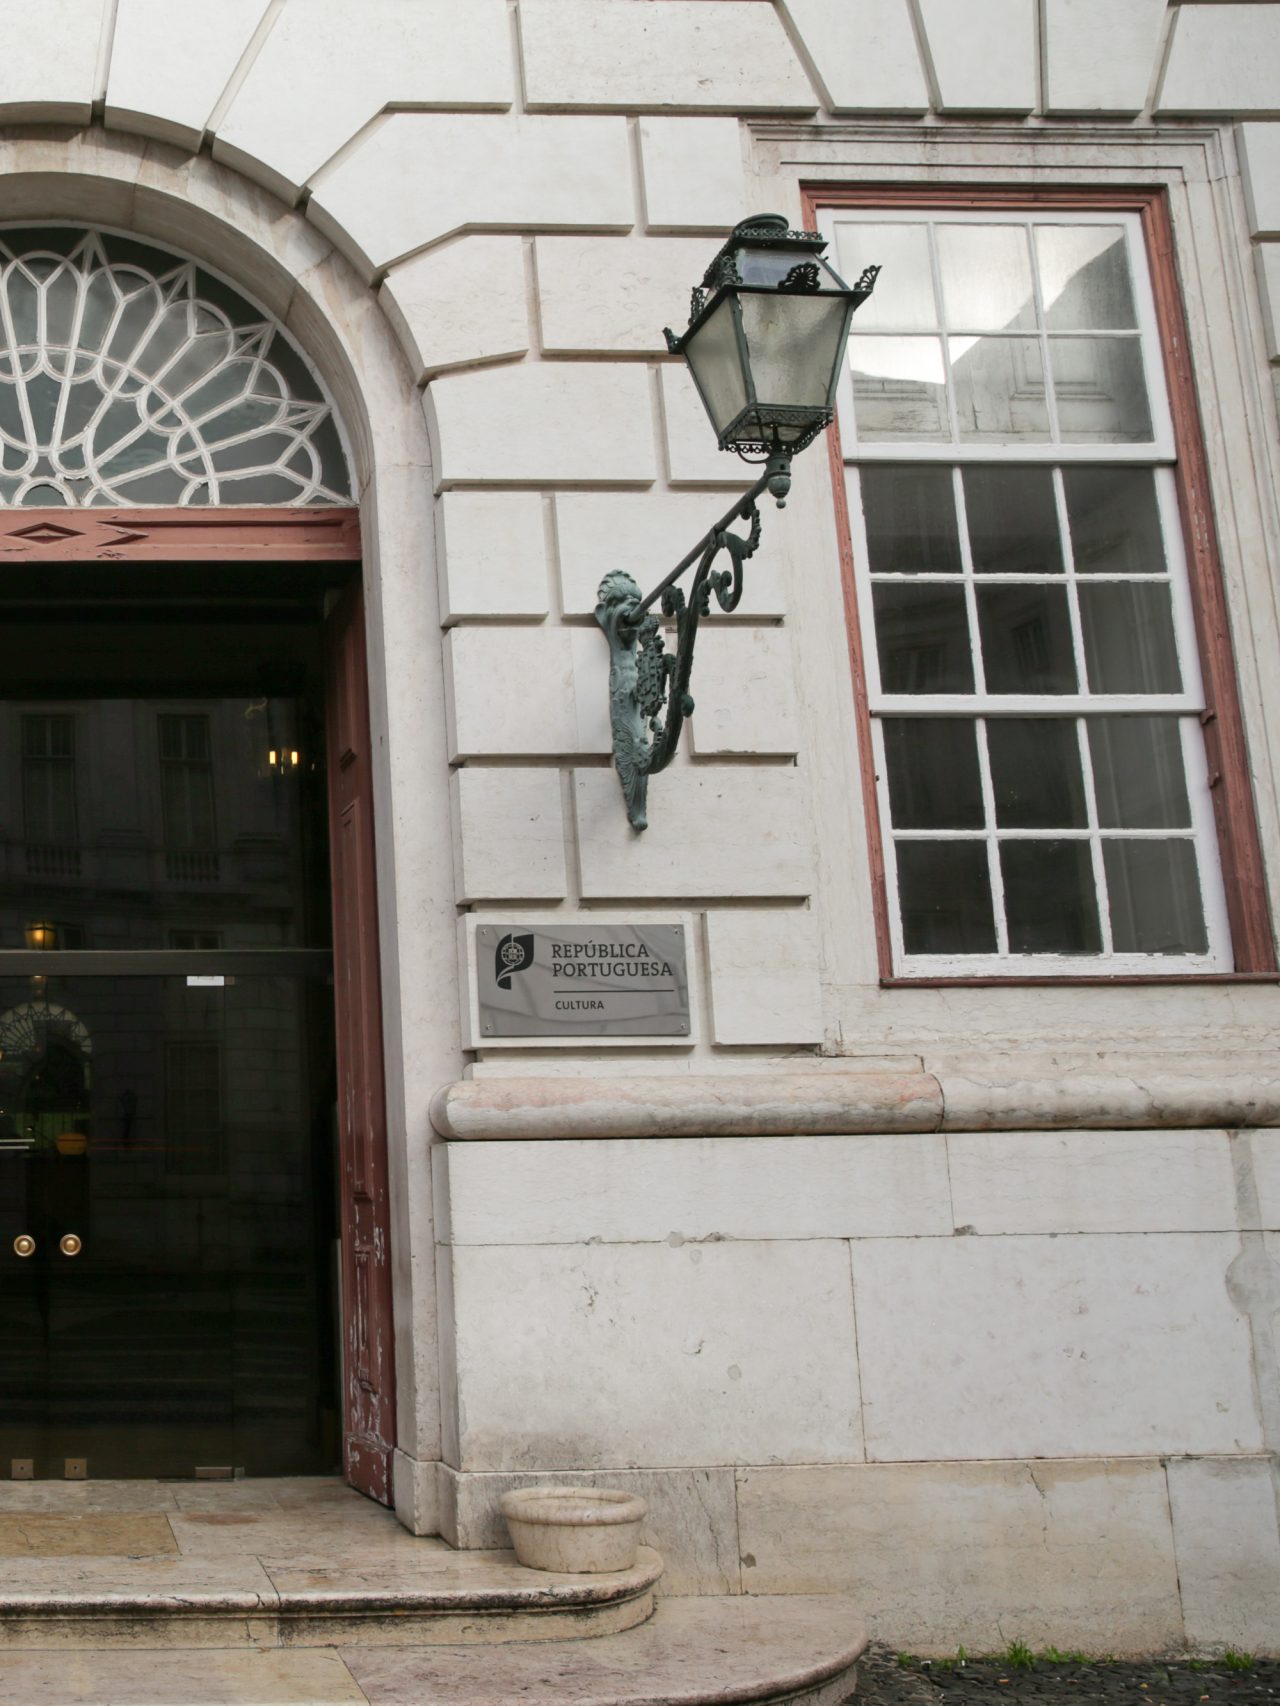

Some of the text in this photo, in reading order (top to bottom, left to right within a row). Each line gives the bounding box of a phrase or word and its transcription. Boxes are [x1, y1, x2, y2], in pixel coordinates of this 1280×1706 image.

[552, 940, 649, 958] REPÚBLICA
[552, 963, 673, 977] PORTUGUESA
[555, 1000, 605, 1010] CULTURA
